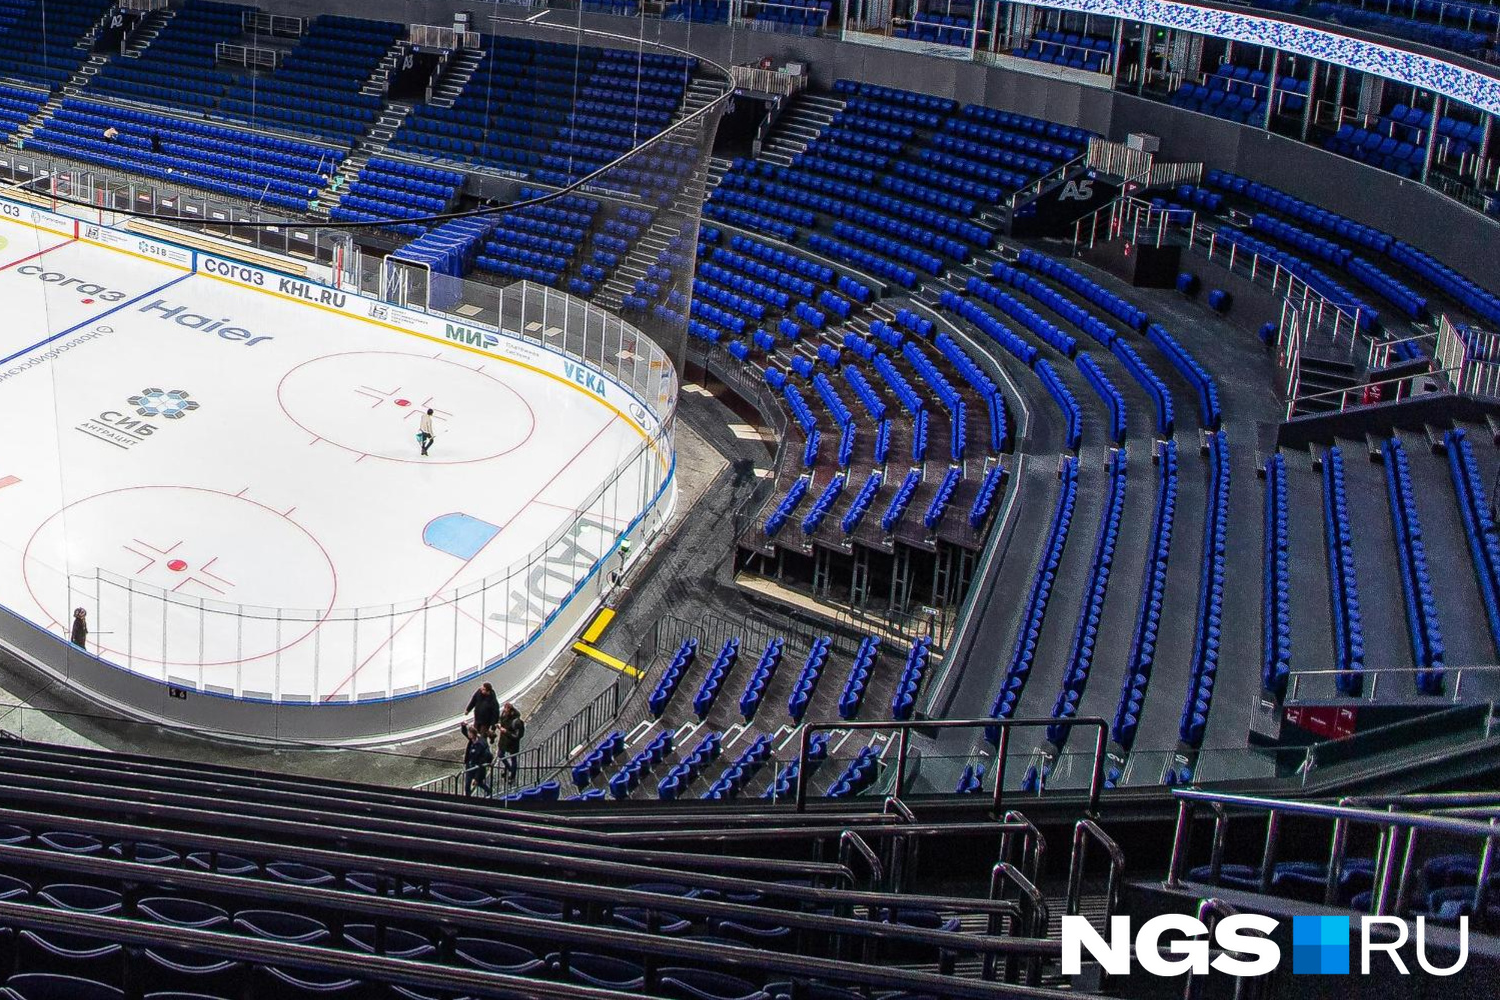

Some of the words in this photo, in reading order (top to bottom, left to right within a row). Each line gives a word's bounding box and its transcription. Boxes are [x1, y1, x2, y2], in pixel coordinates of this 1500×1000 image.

[110, 14, 123, 29] A2
[402, 54, 414, 71] A3
[1058, 179, 1094, 201] A5
[278, 277, 346, 308] KHL.RU
[137, 299, 274, 350] Haier
[445, 324, 499, 349] МИР
[563, 360, 606, 398] VEKA
[80, 422, 138, 446] АНТРАЦИТ
[99, 411, 160, 436] СИБ
